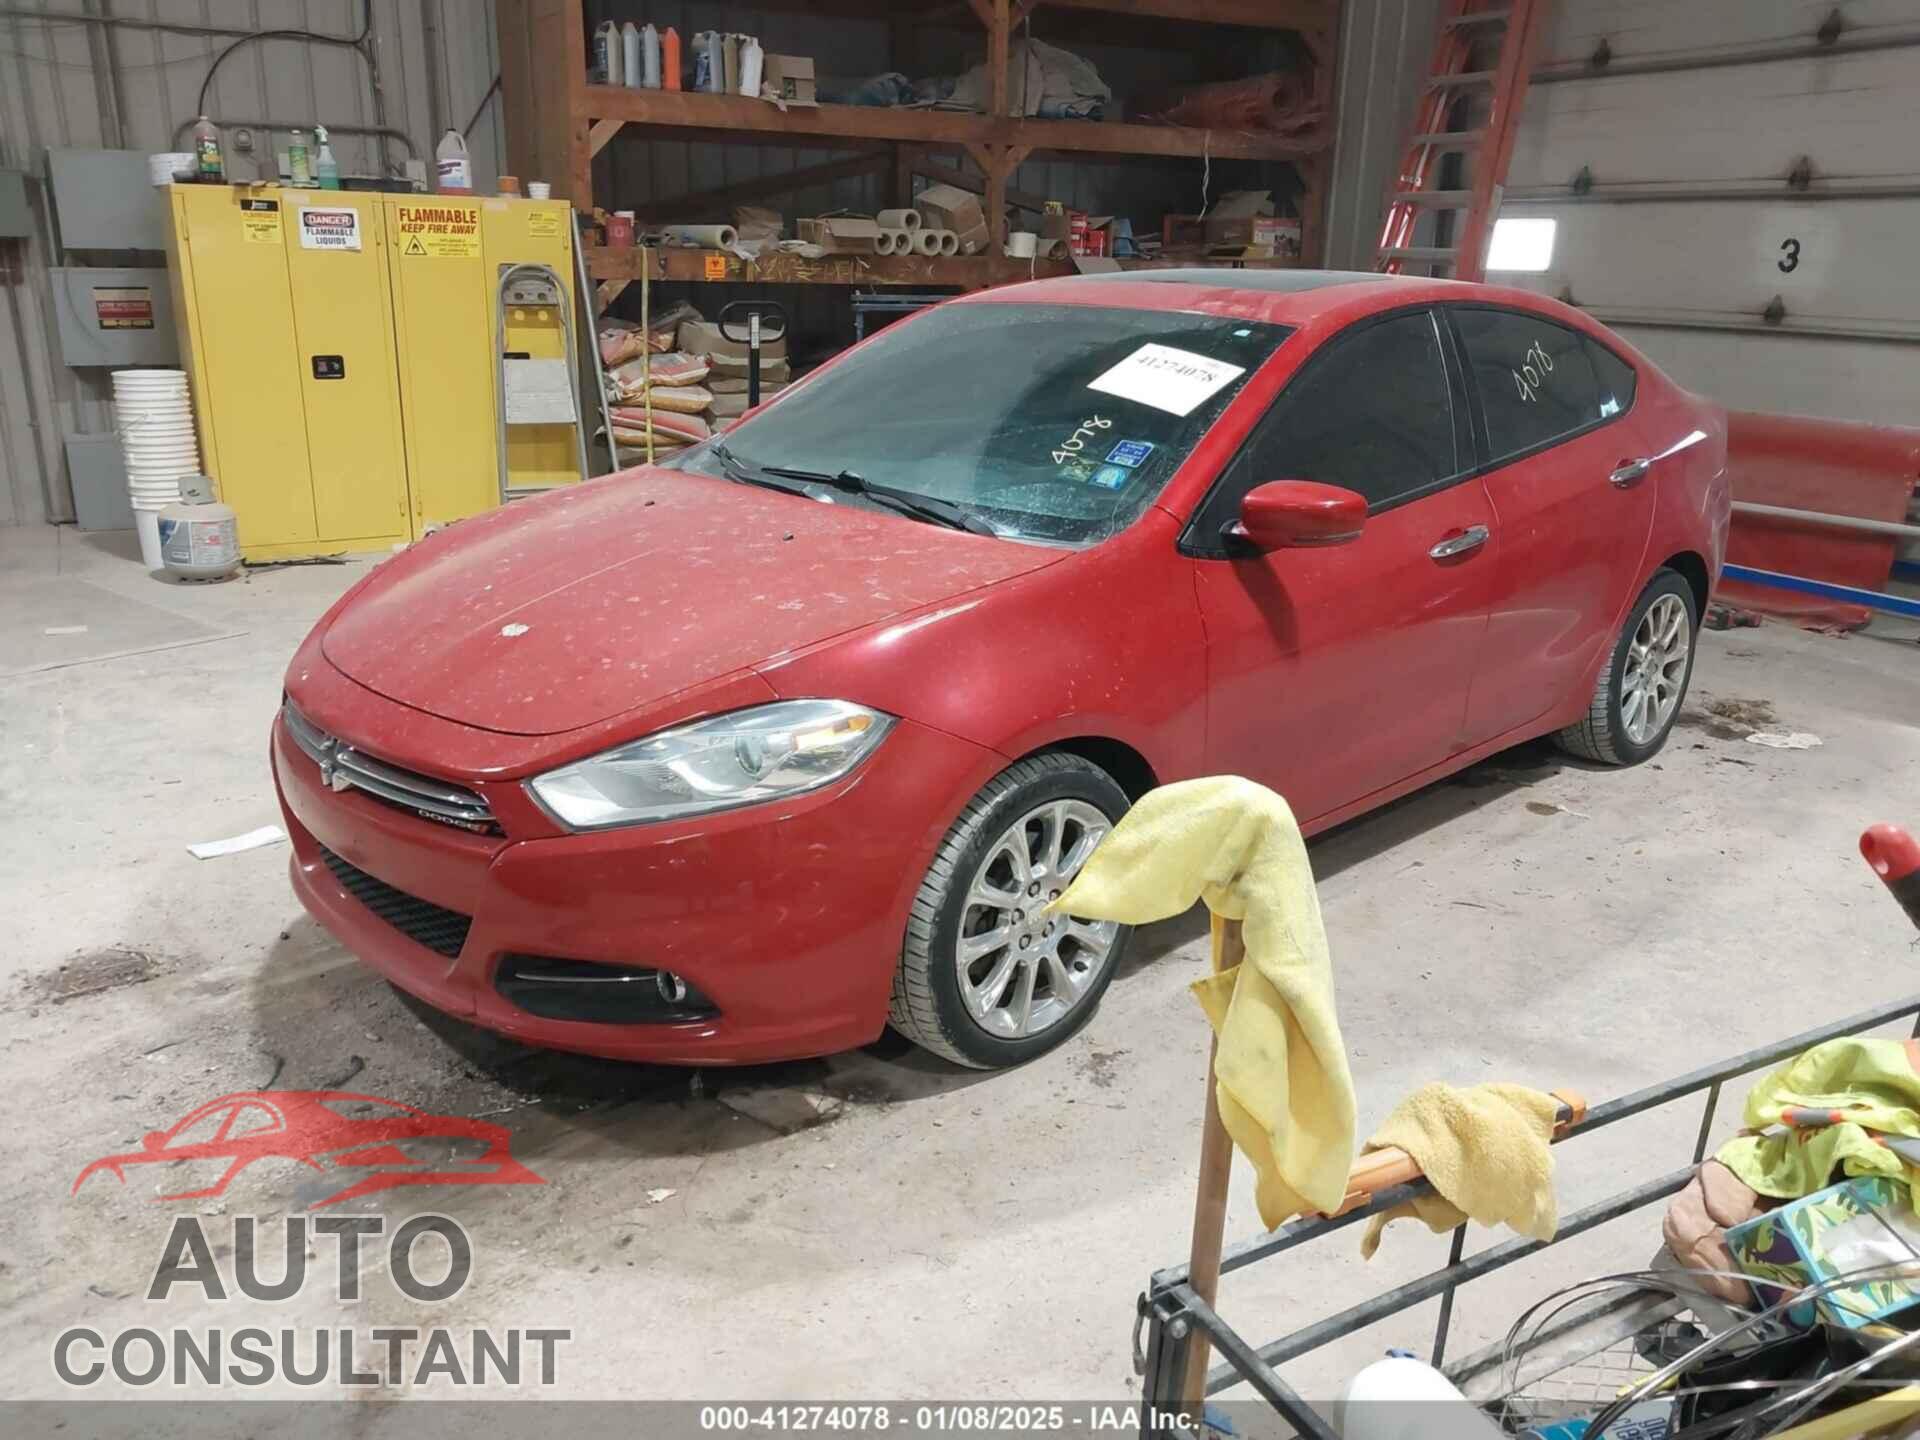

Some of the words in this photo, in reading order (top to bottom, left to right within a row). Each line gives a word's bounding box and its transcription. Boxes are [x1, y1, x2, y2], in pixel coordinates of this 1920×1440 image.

[308, 214, 350, 226] DANGER
[399, 207, 477, 224] FLAMMABLE
[306, 228, 354, 237] FLAMMABLE
[401, 223, 425, 233] KEEP
[427, 224, 449, 234] FIRE
[450, 225, 476, 235] AWAY
[316, 237, 346, 245] LIQUIDS
[1778, 238, 1800, 273] 3
[1137, 355, 1217, 383] 41274078
[1512, 340, 1553, 402] 4078
[1051, 414, 1112, 464] 4078
[418, 809, 480, 832] DODGE
